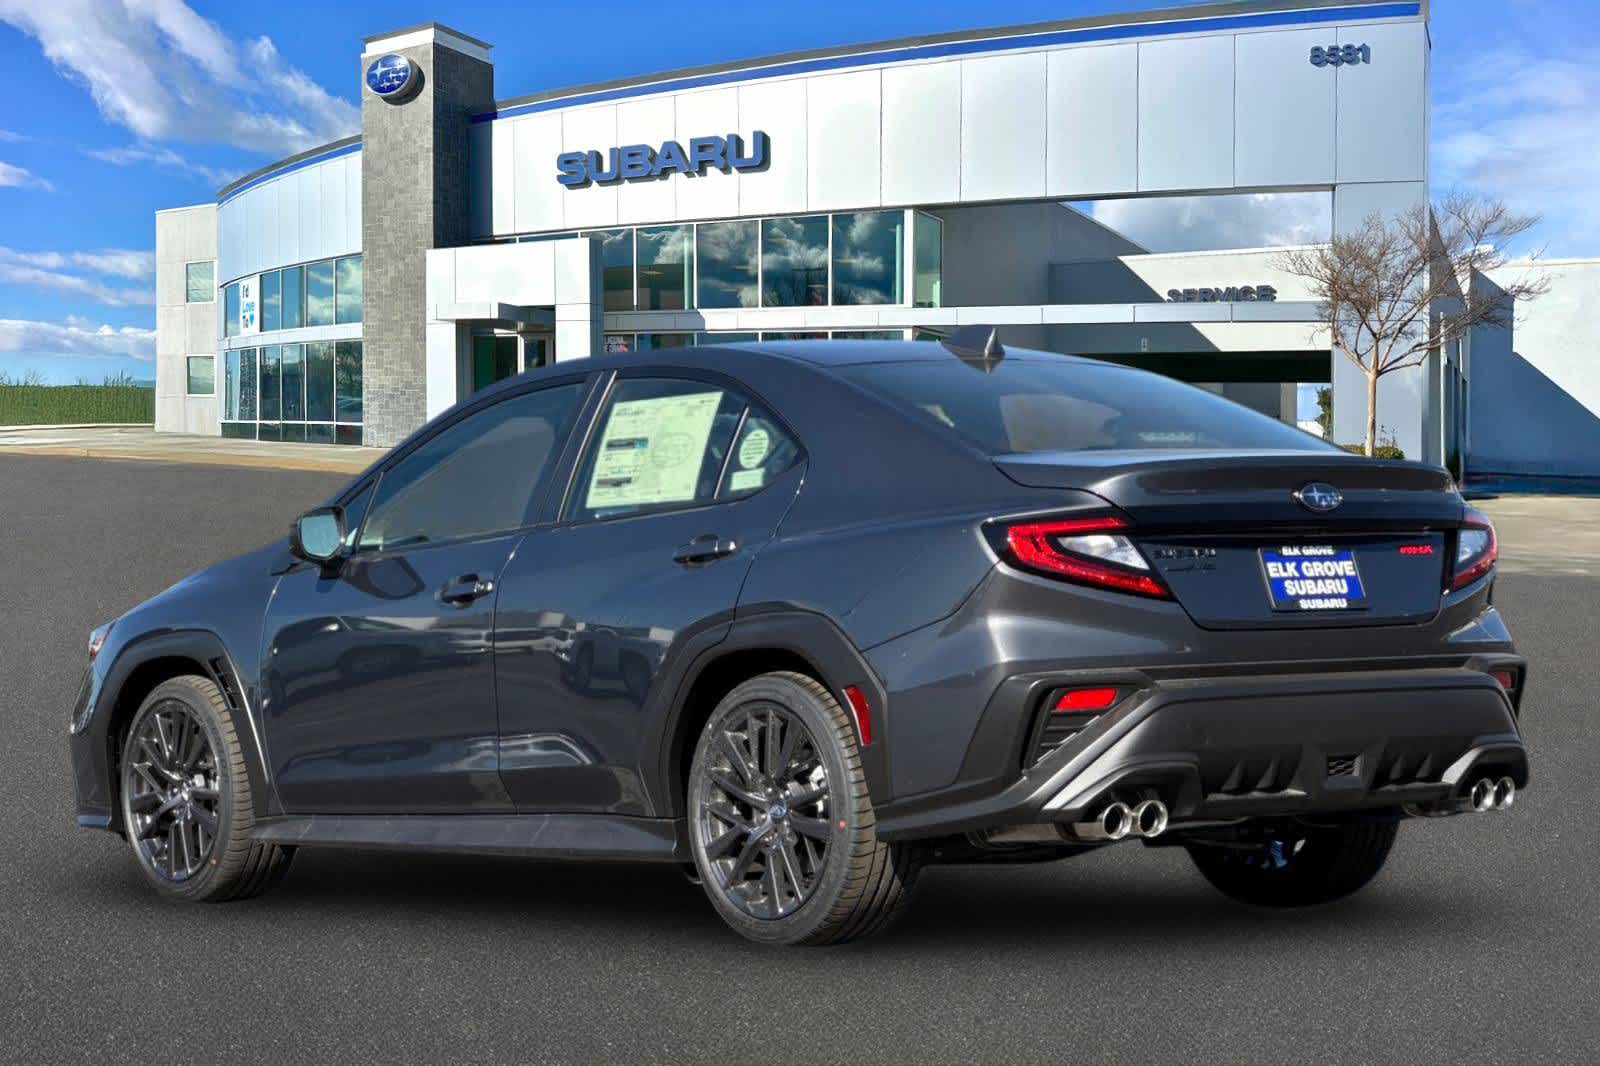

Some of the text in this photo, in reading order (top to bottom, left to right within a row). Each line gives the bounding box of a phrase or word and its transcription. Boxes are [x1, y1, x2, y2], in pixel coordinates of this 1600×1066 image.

[556, 130, 771, 190] SUBARU
[1167, 285, 1277, 302] SERVICE
[1281, 545, 1334, 556] ELK GROVE
[1266, 560, 1356, 577] ELK GROVE
[1284, 579, 1348, 595] SUBARU
[1299, 598, 1347, 609] SUBARU
